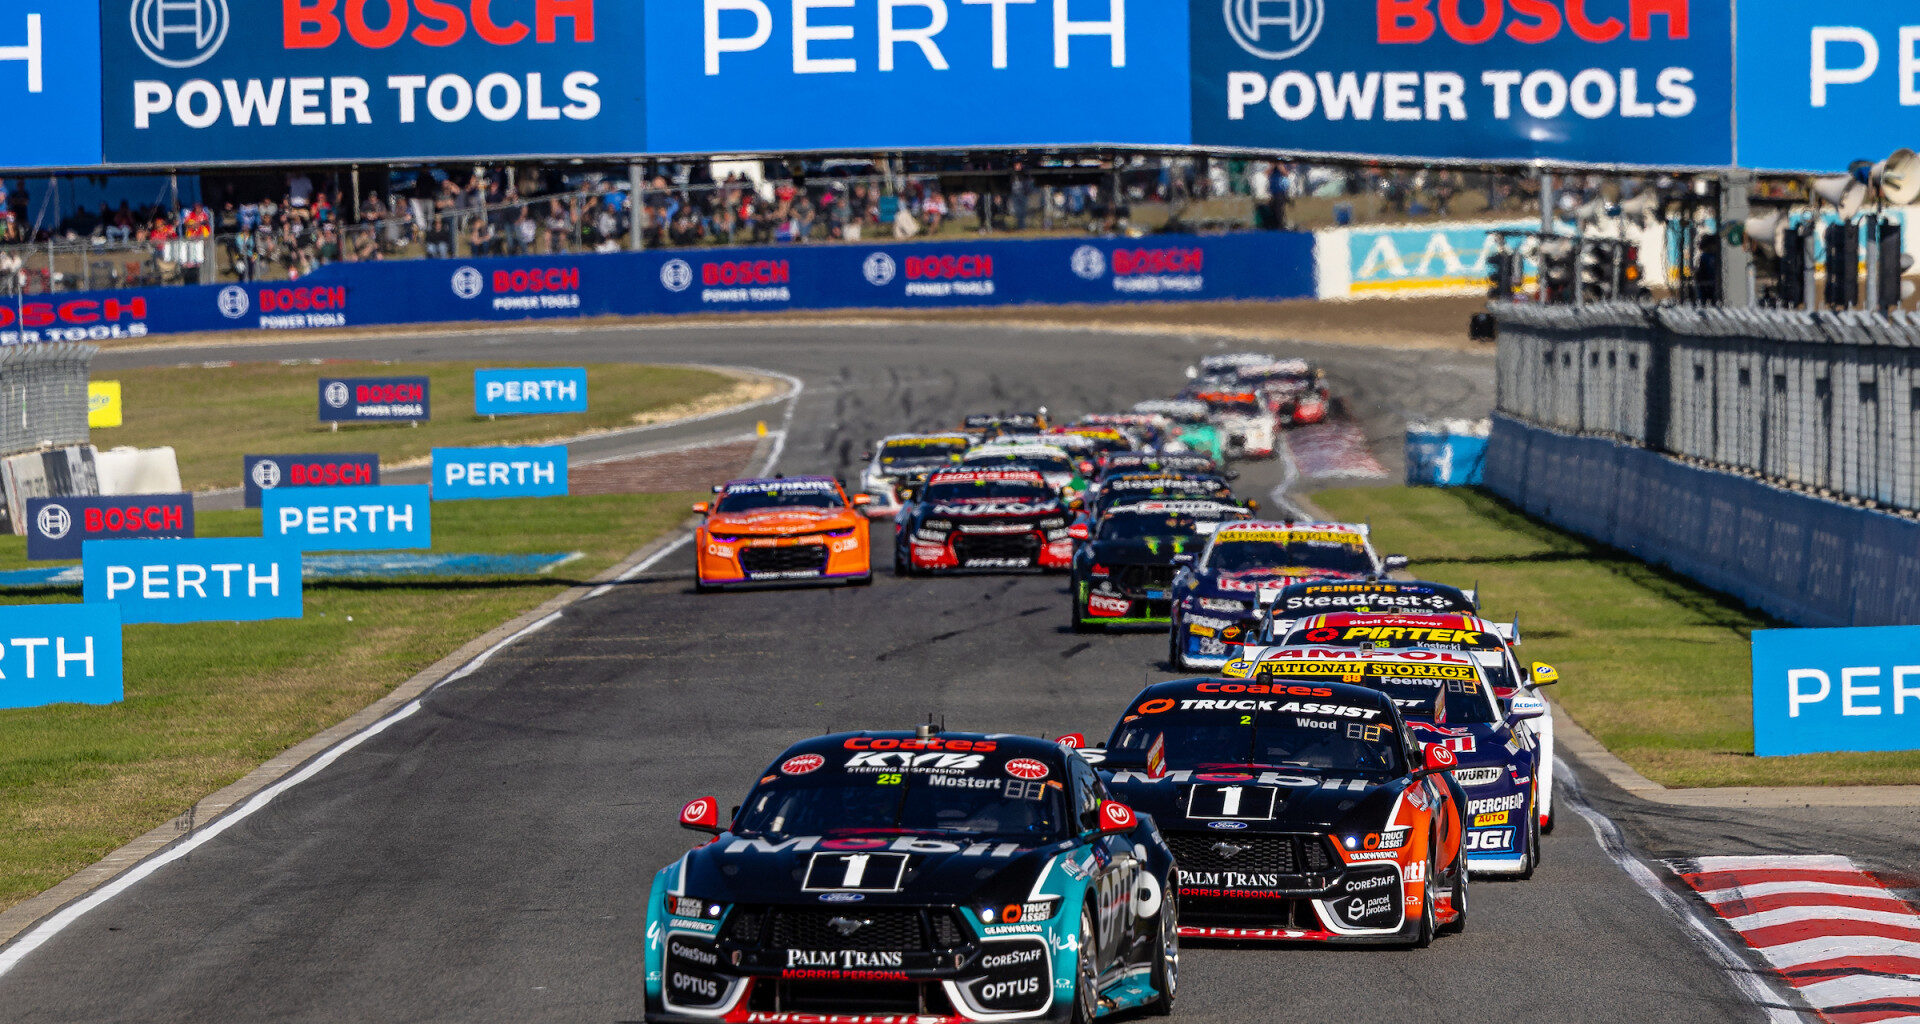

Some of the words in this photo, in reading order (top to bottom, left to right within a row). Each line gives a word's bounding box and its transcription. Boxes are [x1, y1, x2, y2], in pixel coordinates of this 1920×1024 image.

[283, 0, 595, 48] BOSCH
[1376, 0, 1690, 44] BOSCH
[704, 0, 1126, 75] PERTH
[134, 77, 372, 129] POWER
[388, 71, 601, 123] TOOLS
[1227, 71, 1466, 120] POWER
[1481, 67, 1695, 118] TOOLS
[702, 259, 790, 286] BOSCH
[905, 254, 993, 279] BOSCH
[493, 267, 580, 293] BOSCH
[259, 285, 346, 312] BOSCH
[356, 384, 424, 404] BOSCH
[486, 380, 578, 402] PERTH
[290, 462, 372, 485] BOSCH
[445, 461, 556, 487] PERTH
[84, 505, 184, 533] BOSCH
[279, 504, 414, 535] PERTH
[106, 562, 280, 599] PERTH
[1306, 584, 1397, 594] PENRITE
[1286, 593, 1421, 609] Steadfast
[1384, 619, 1443, 627] V-Power
[1343, 626, 1482, 645] PIRTEK
[1374, 640, 1390, 648] 38
[1416, 641, 1461, 651] Kostecki
[0, 636, 95, 680] TH
[1267, 648, 1468, 664] AMPOL
[1260, 663, 1361, 674] NATIONAL
[1372, 664, 1471, 678] STORAGE
[1342, 674, 1362, 683] 88
[1197, 682, 1333, 698] Coates
[1380, 676, 1443, 688] Feeney
[1180, 699, 1273, 711] TRUCK
[1278, 701, 1382, 719] ASSIST
[1240, 715, 1251, 725] 2
[1296, 717, 1337, 731] Wood
[844, 737, 997, 752] Coates
[844, 752, 985, 769] KYB
[1012, 762, 1042, 771] NGK
[876, 773, 903, 785] 25
[929, 774, 1001, 789] Mostert
[1111, 768, 1369, 791] Mobil
[1216, 785, 1243, 815] 1
[1478, 813, 1504, 823] AUTO
[1378, 839, 1403, 849] ASSIST
[1380, 831, 1404, 840] TRUCK
[724, 836, 1021, 857] Mobil
[1349, 851, 1398, 860] GEARWRENCH
[839, 853, 871, 888] 1
[1178, 870, 1220, 886] PALM
[1223, 871, 1278, 888] TRANS
[1178, 888, 1221, 897] ORRIS
[1223, 890, 1282, 898] PERSONAL
[1367, 894, 1390, 907] parcel
[1022, 902, 1051, 912] TRUCK
[1366, 903, 1391, 917] protect
[1020, 912, 1050, 922] ASSIST
[984, 925, 1043, 935] GEARWRENCH
[786, 949, 836, 968] PALM
[840, 950, 902, 968] TRANS
[782, 969, 840, 980] MORRIS
[843, 970, 909, 980] PERSONAL
[673, 972, 718, 998] OPTUS
[982, 977, 1040, 1000] OPTUS
